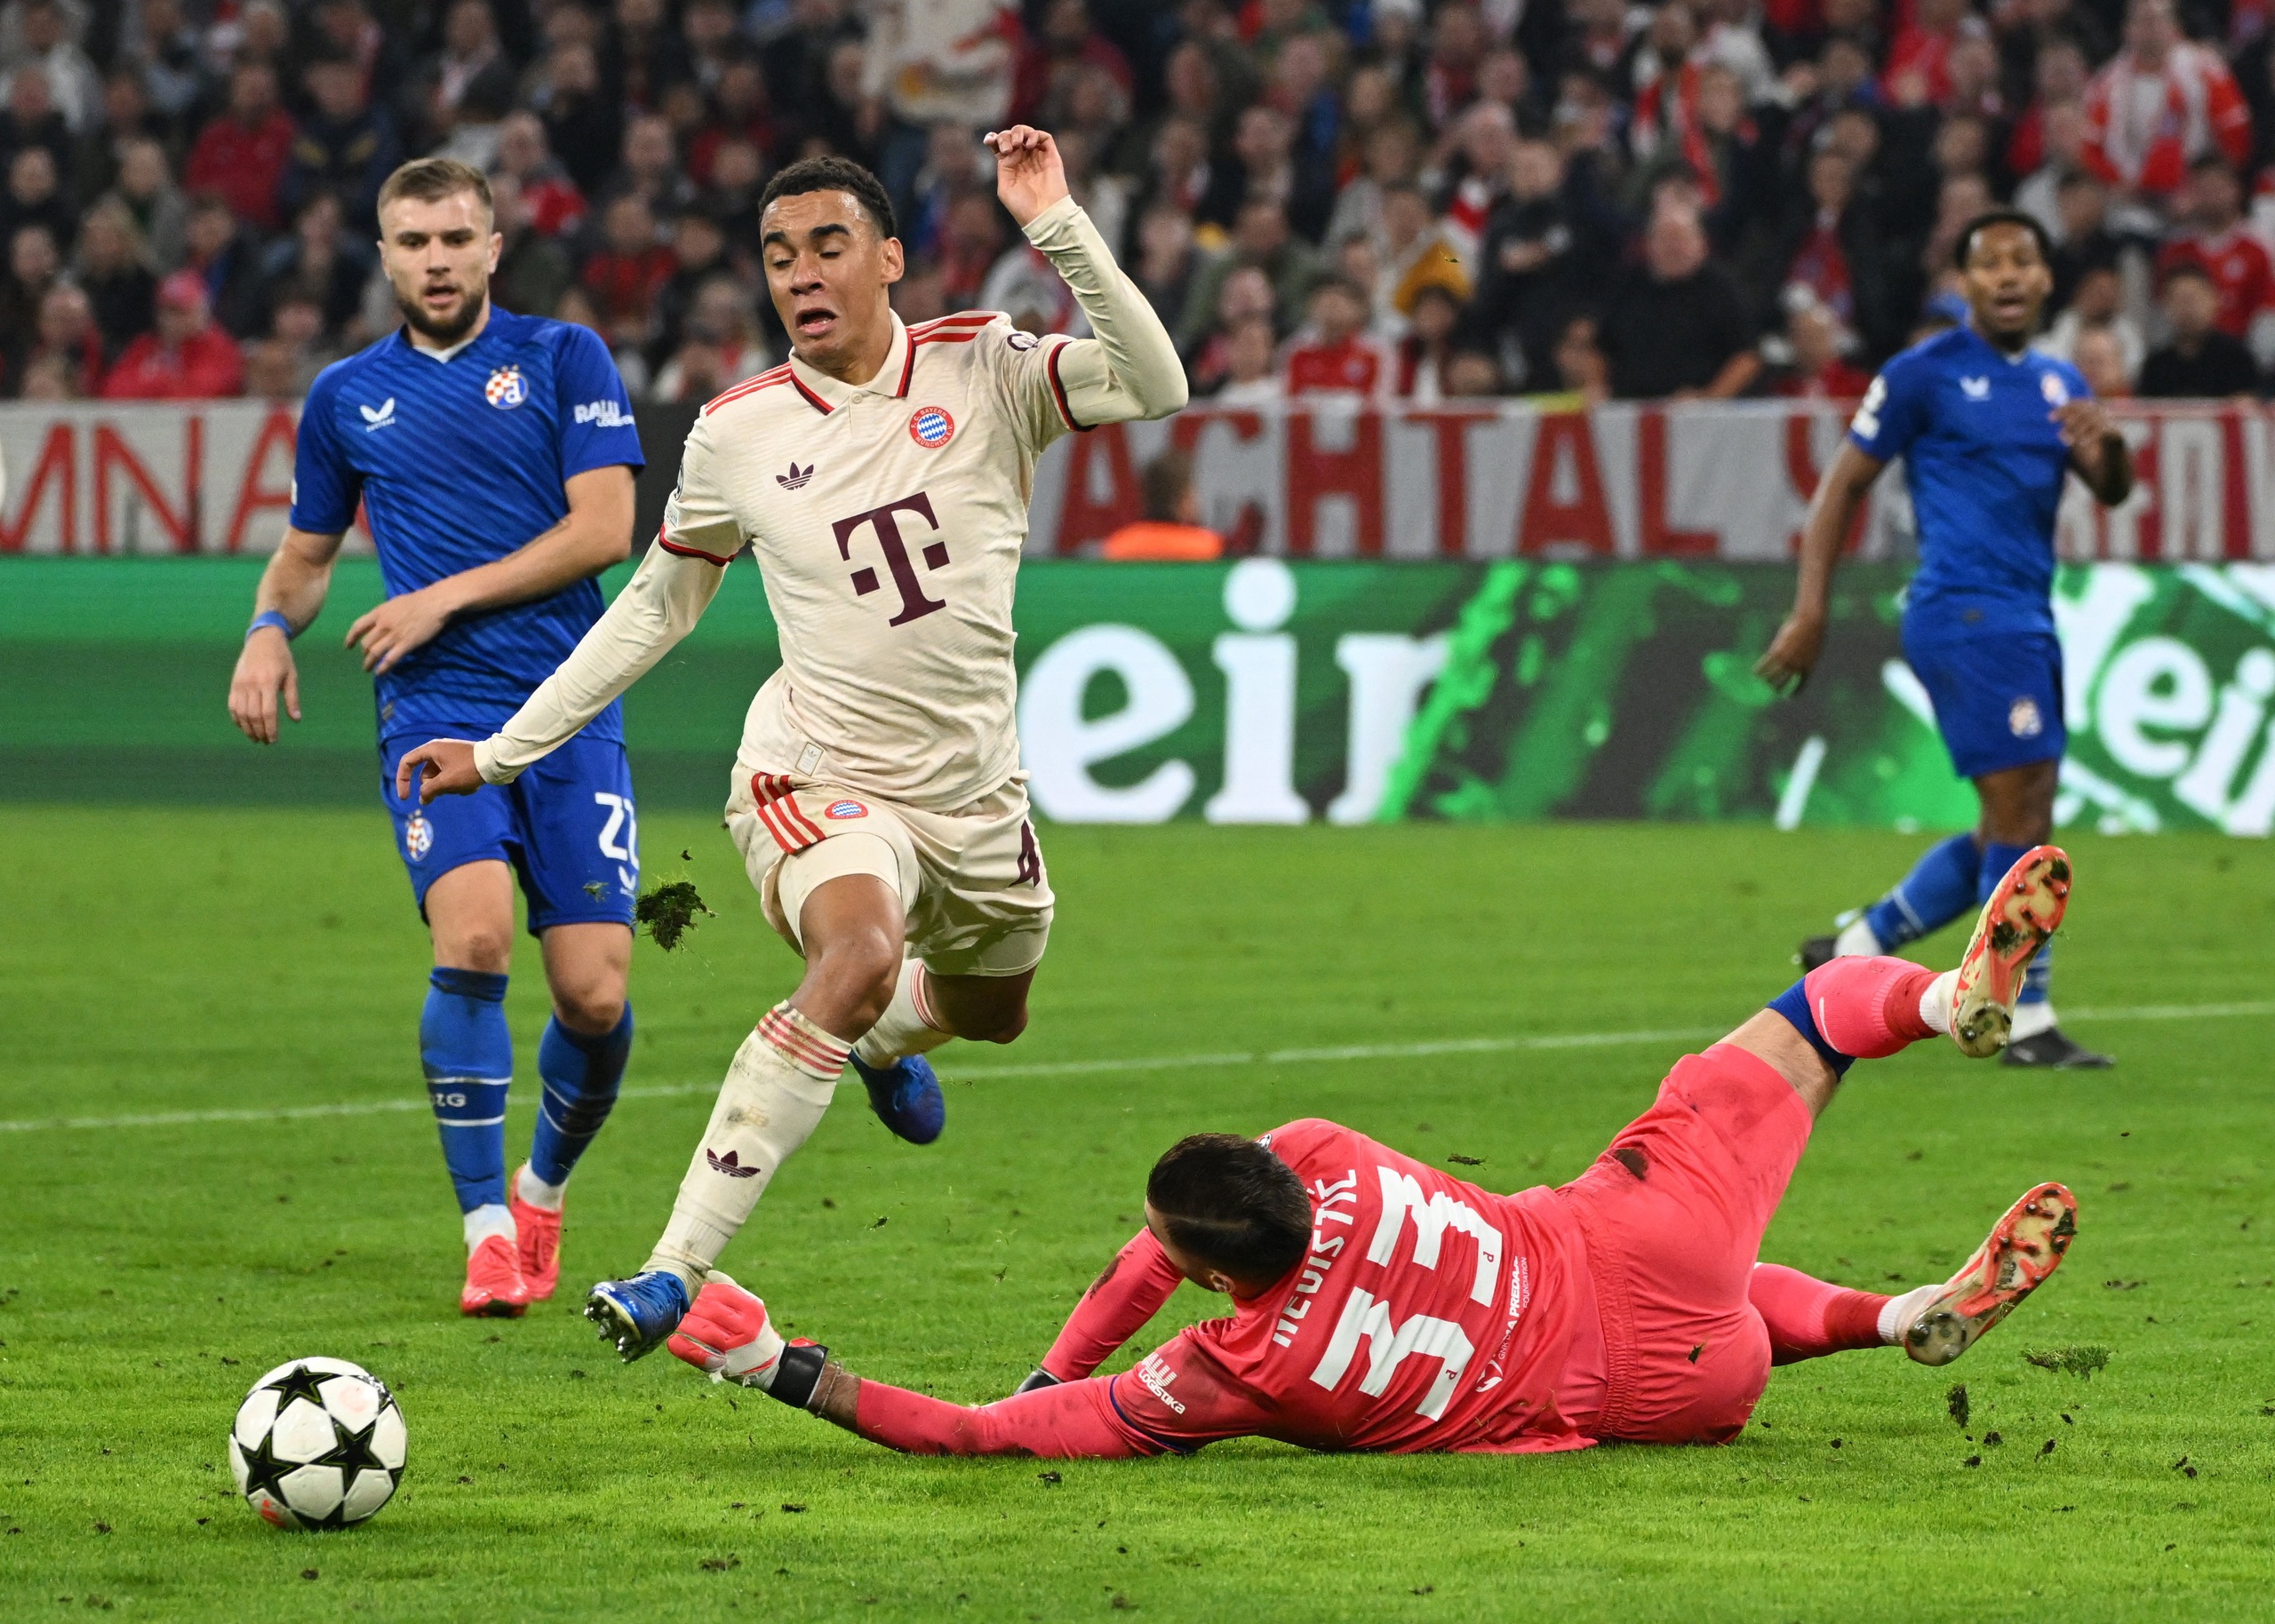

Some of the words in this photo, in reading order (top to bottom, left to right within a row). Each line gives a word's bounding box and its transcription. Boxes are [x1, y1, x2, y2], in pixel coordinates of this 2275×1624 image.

[920, 408, 947, 417] BAYERN
[1310, 1166, 1503, 1421] 33
[1521, 1256, 1530, 1308] FOUNDATION
